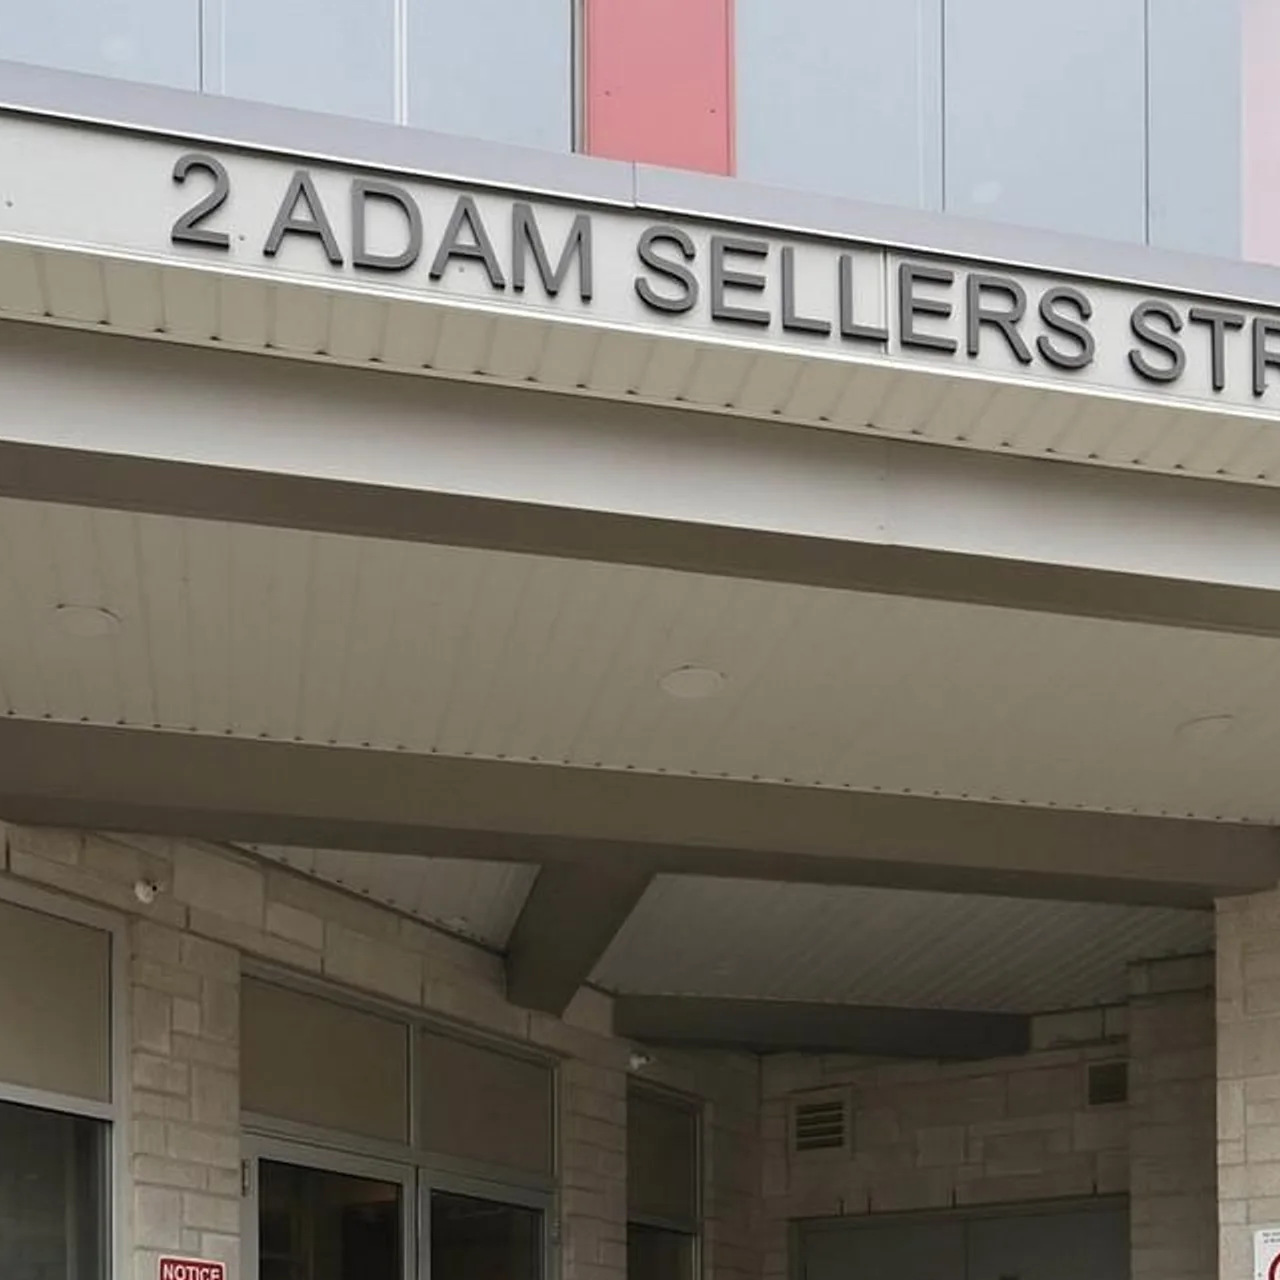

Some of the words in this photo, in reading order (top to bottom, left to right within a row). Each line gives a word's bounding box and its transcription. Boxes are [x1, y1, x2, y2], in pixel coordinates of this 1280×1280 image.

[172, 152, 231, 250] 2
[262, 169, 592, 303] ADAM
[634, 224, 1096, 370] SELLERS
